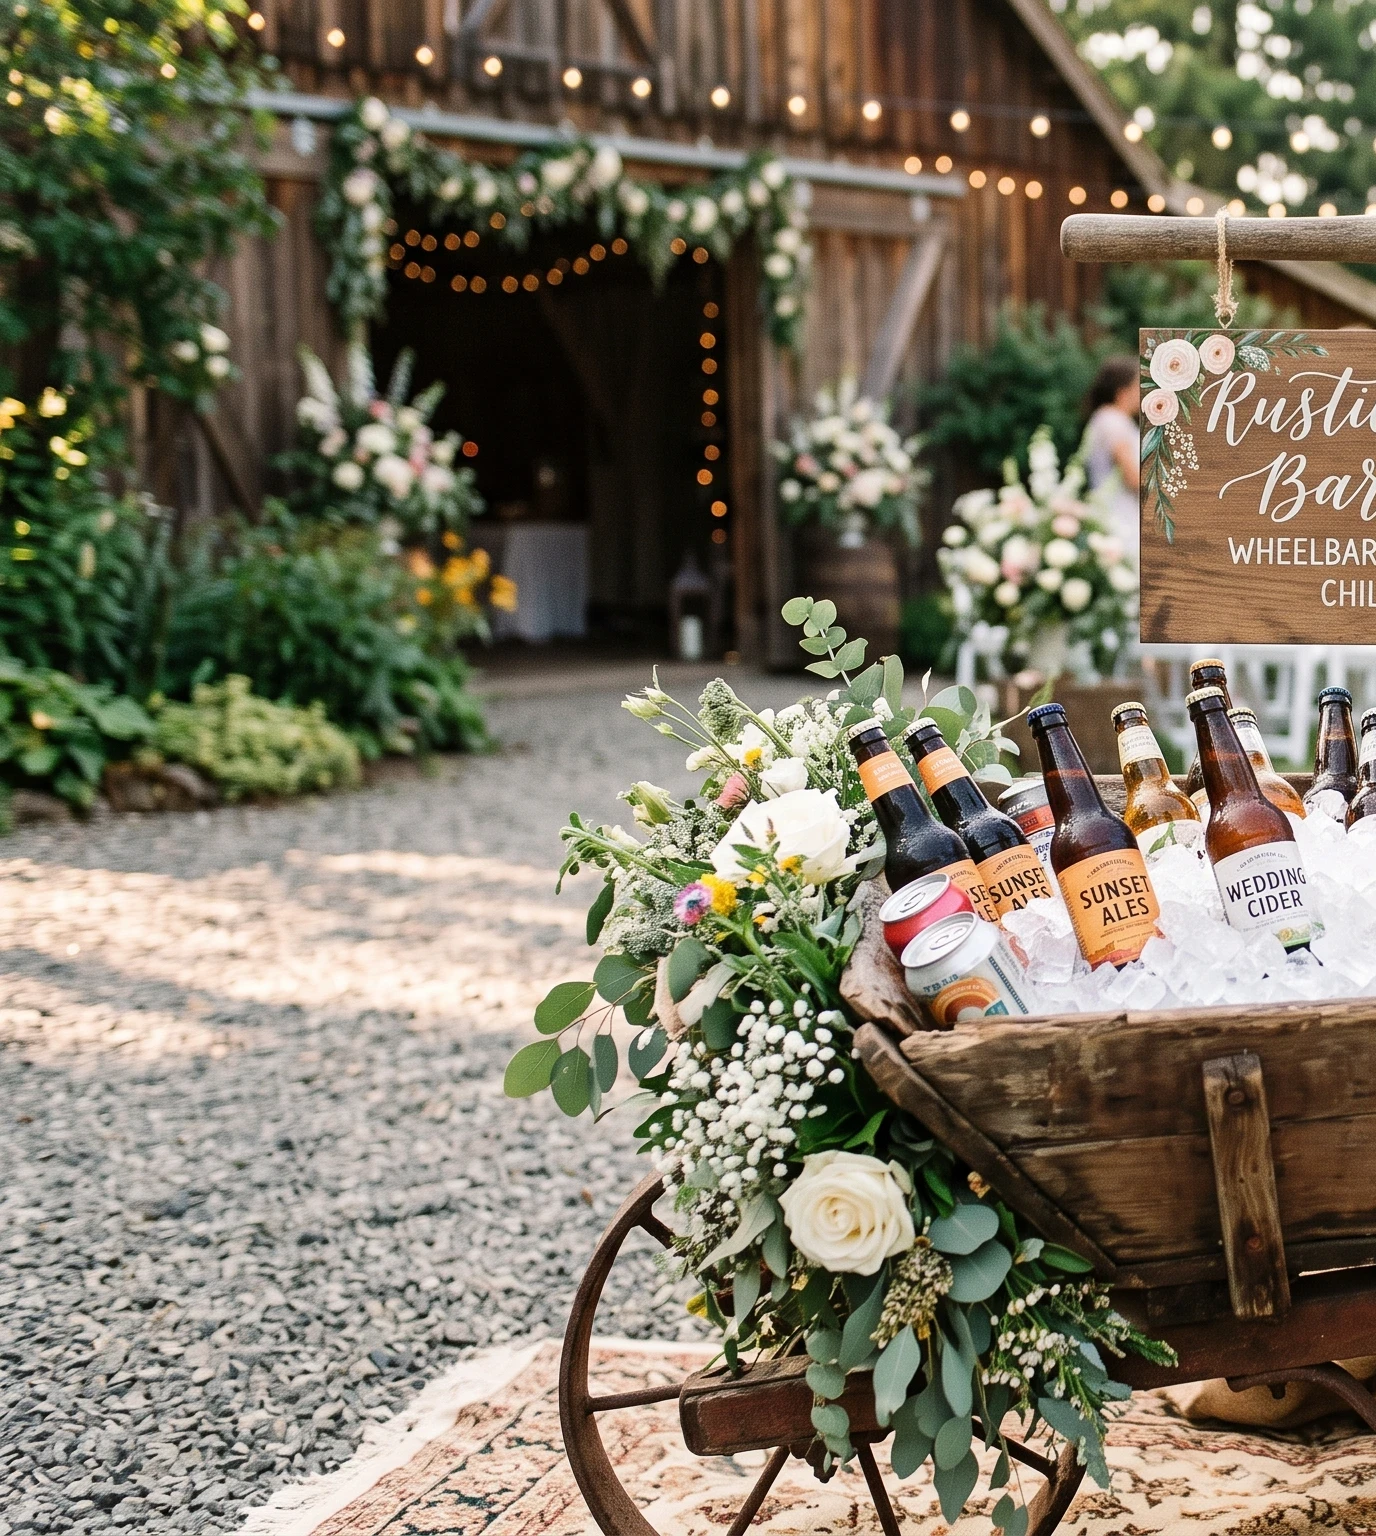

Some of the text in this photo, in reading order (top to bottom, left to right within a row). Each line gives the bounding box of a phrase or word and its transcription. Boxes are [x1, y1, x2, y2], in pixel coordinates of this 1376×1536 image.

[1079, 875, 1150, 910] SUNSET
[1226, 867, 1307, 903] WEDDING
[1102, 897, 1150, 927] ALES
[1247, 889, 1304, 918] CIDER
